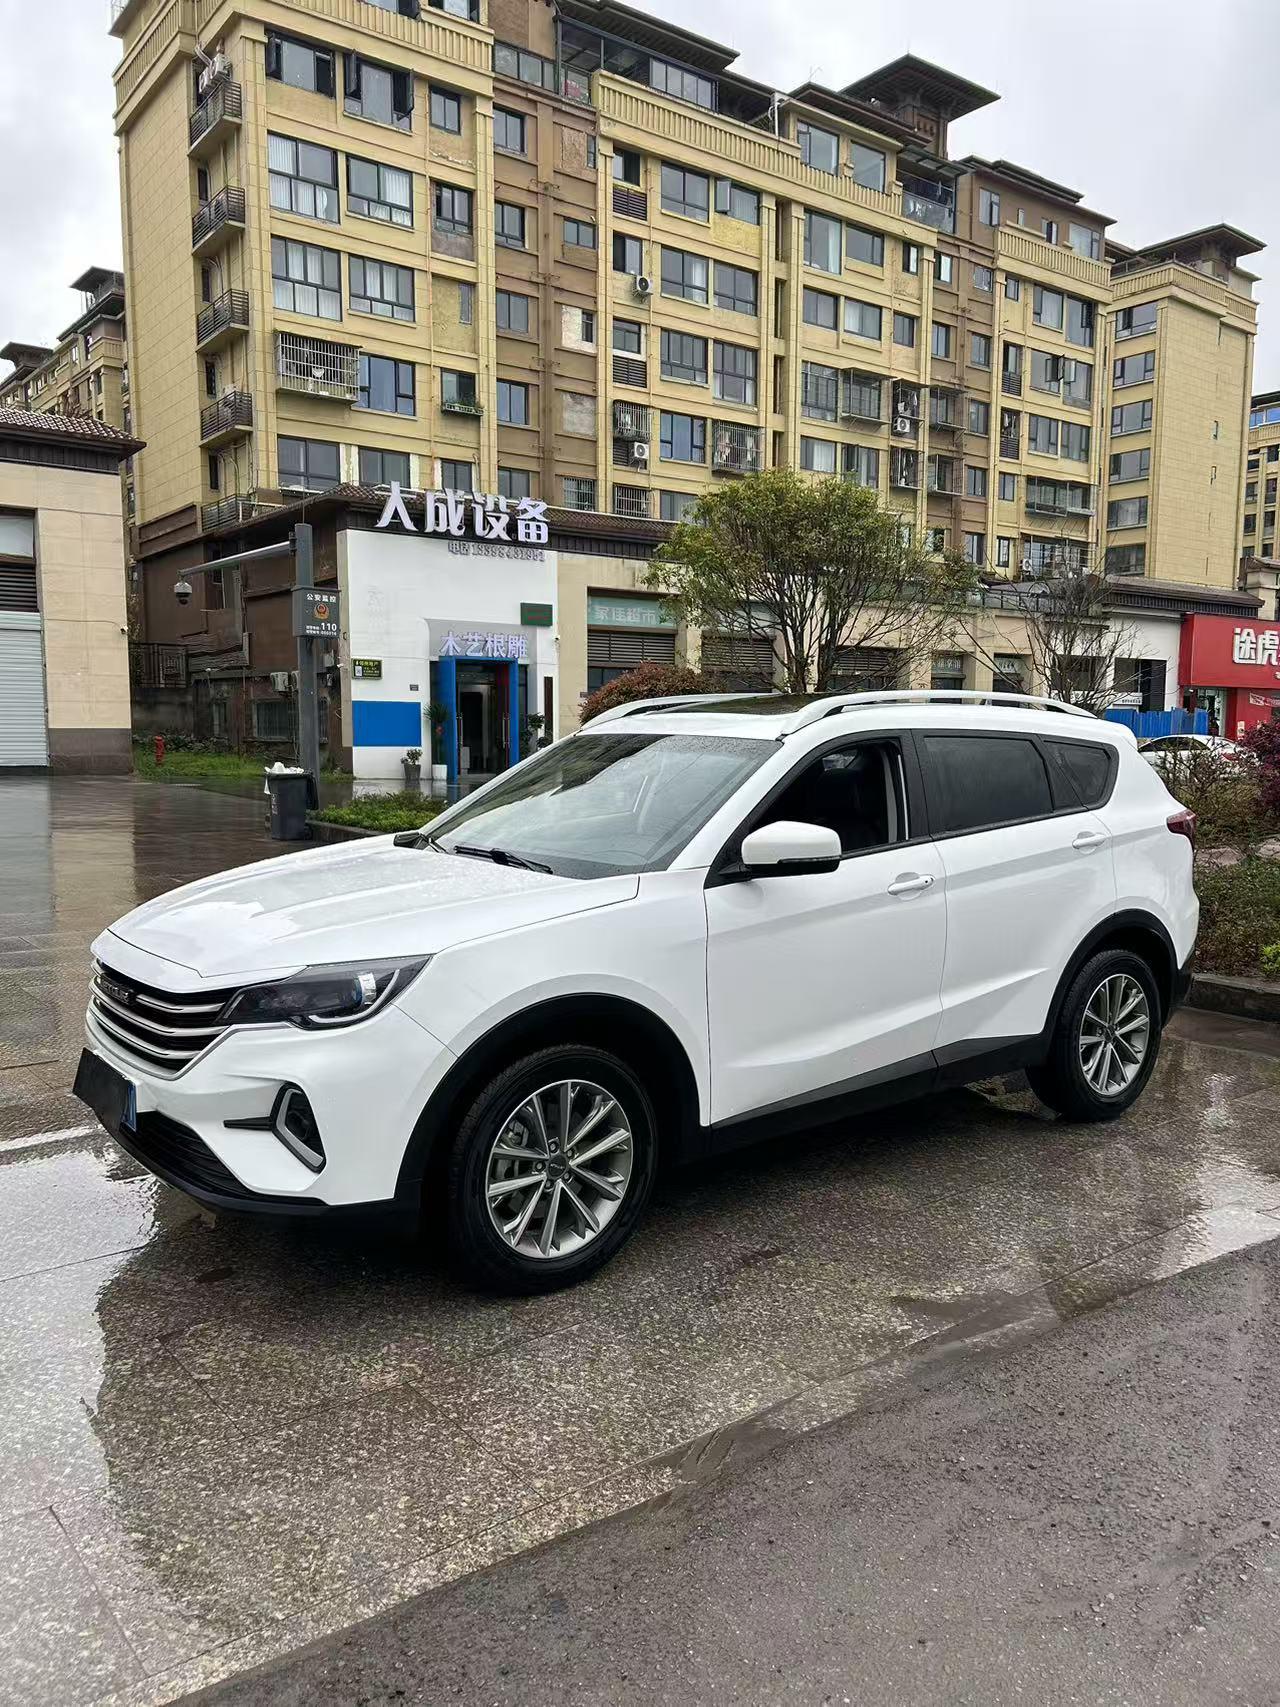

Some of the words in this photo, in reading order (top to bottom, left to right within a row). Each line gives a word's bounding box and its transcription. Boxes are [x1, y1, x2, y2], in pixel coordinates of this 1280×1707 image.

[374, 481, 549, 543] 大成设备
[320, 622, 338, 631] 110
[440, 630, 527, 658] 木艺根雕
